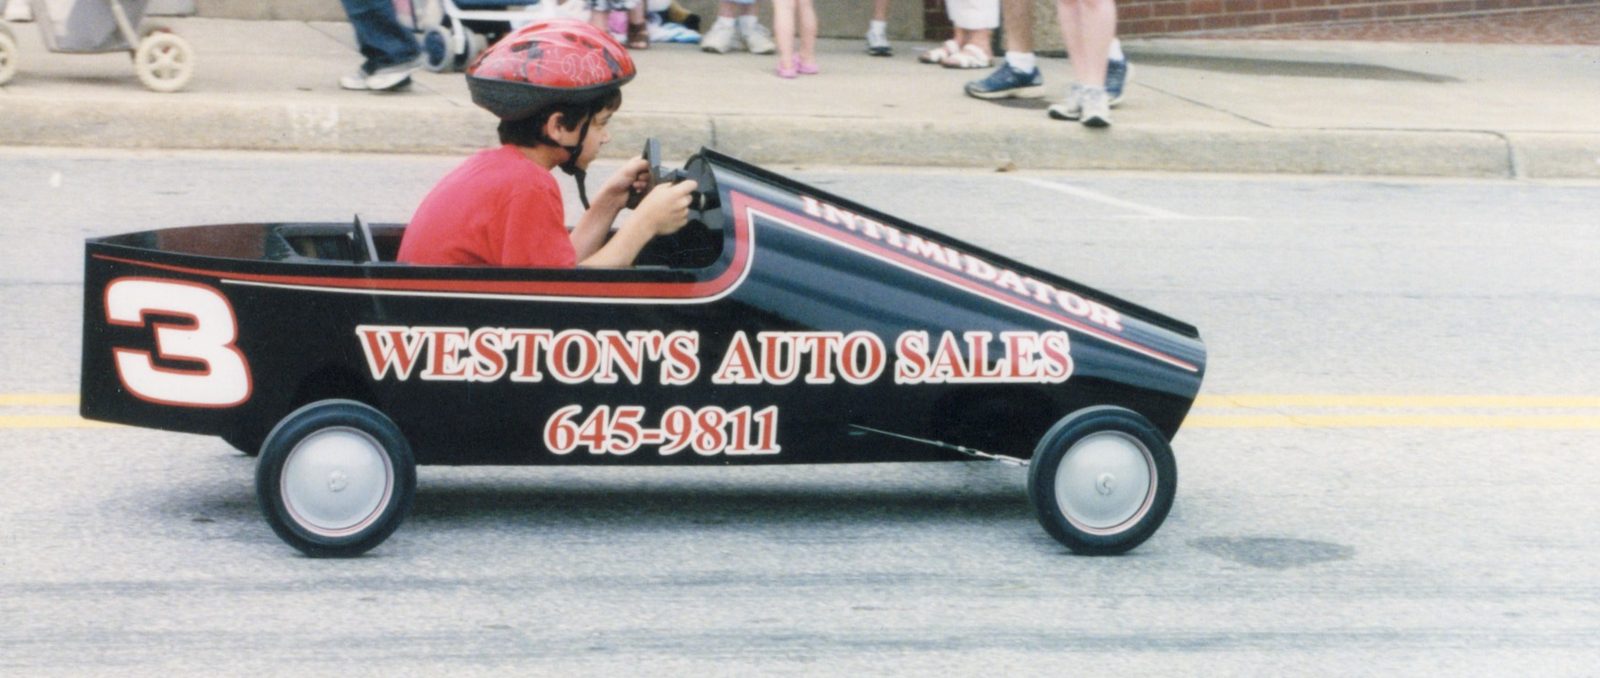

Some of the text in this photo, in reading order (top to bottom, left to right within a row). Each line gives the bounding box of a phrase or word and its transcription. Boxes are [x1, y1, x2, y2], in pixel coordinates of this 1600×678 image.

[801, 195, 1124, 331] INTIMIDATOR
[103, 276, 253, 408] 3
[356, 325, 1074, 385] WESTON'S AUTO SALES
[544, 404, 781, 455] 645-9811
